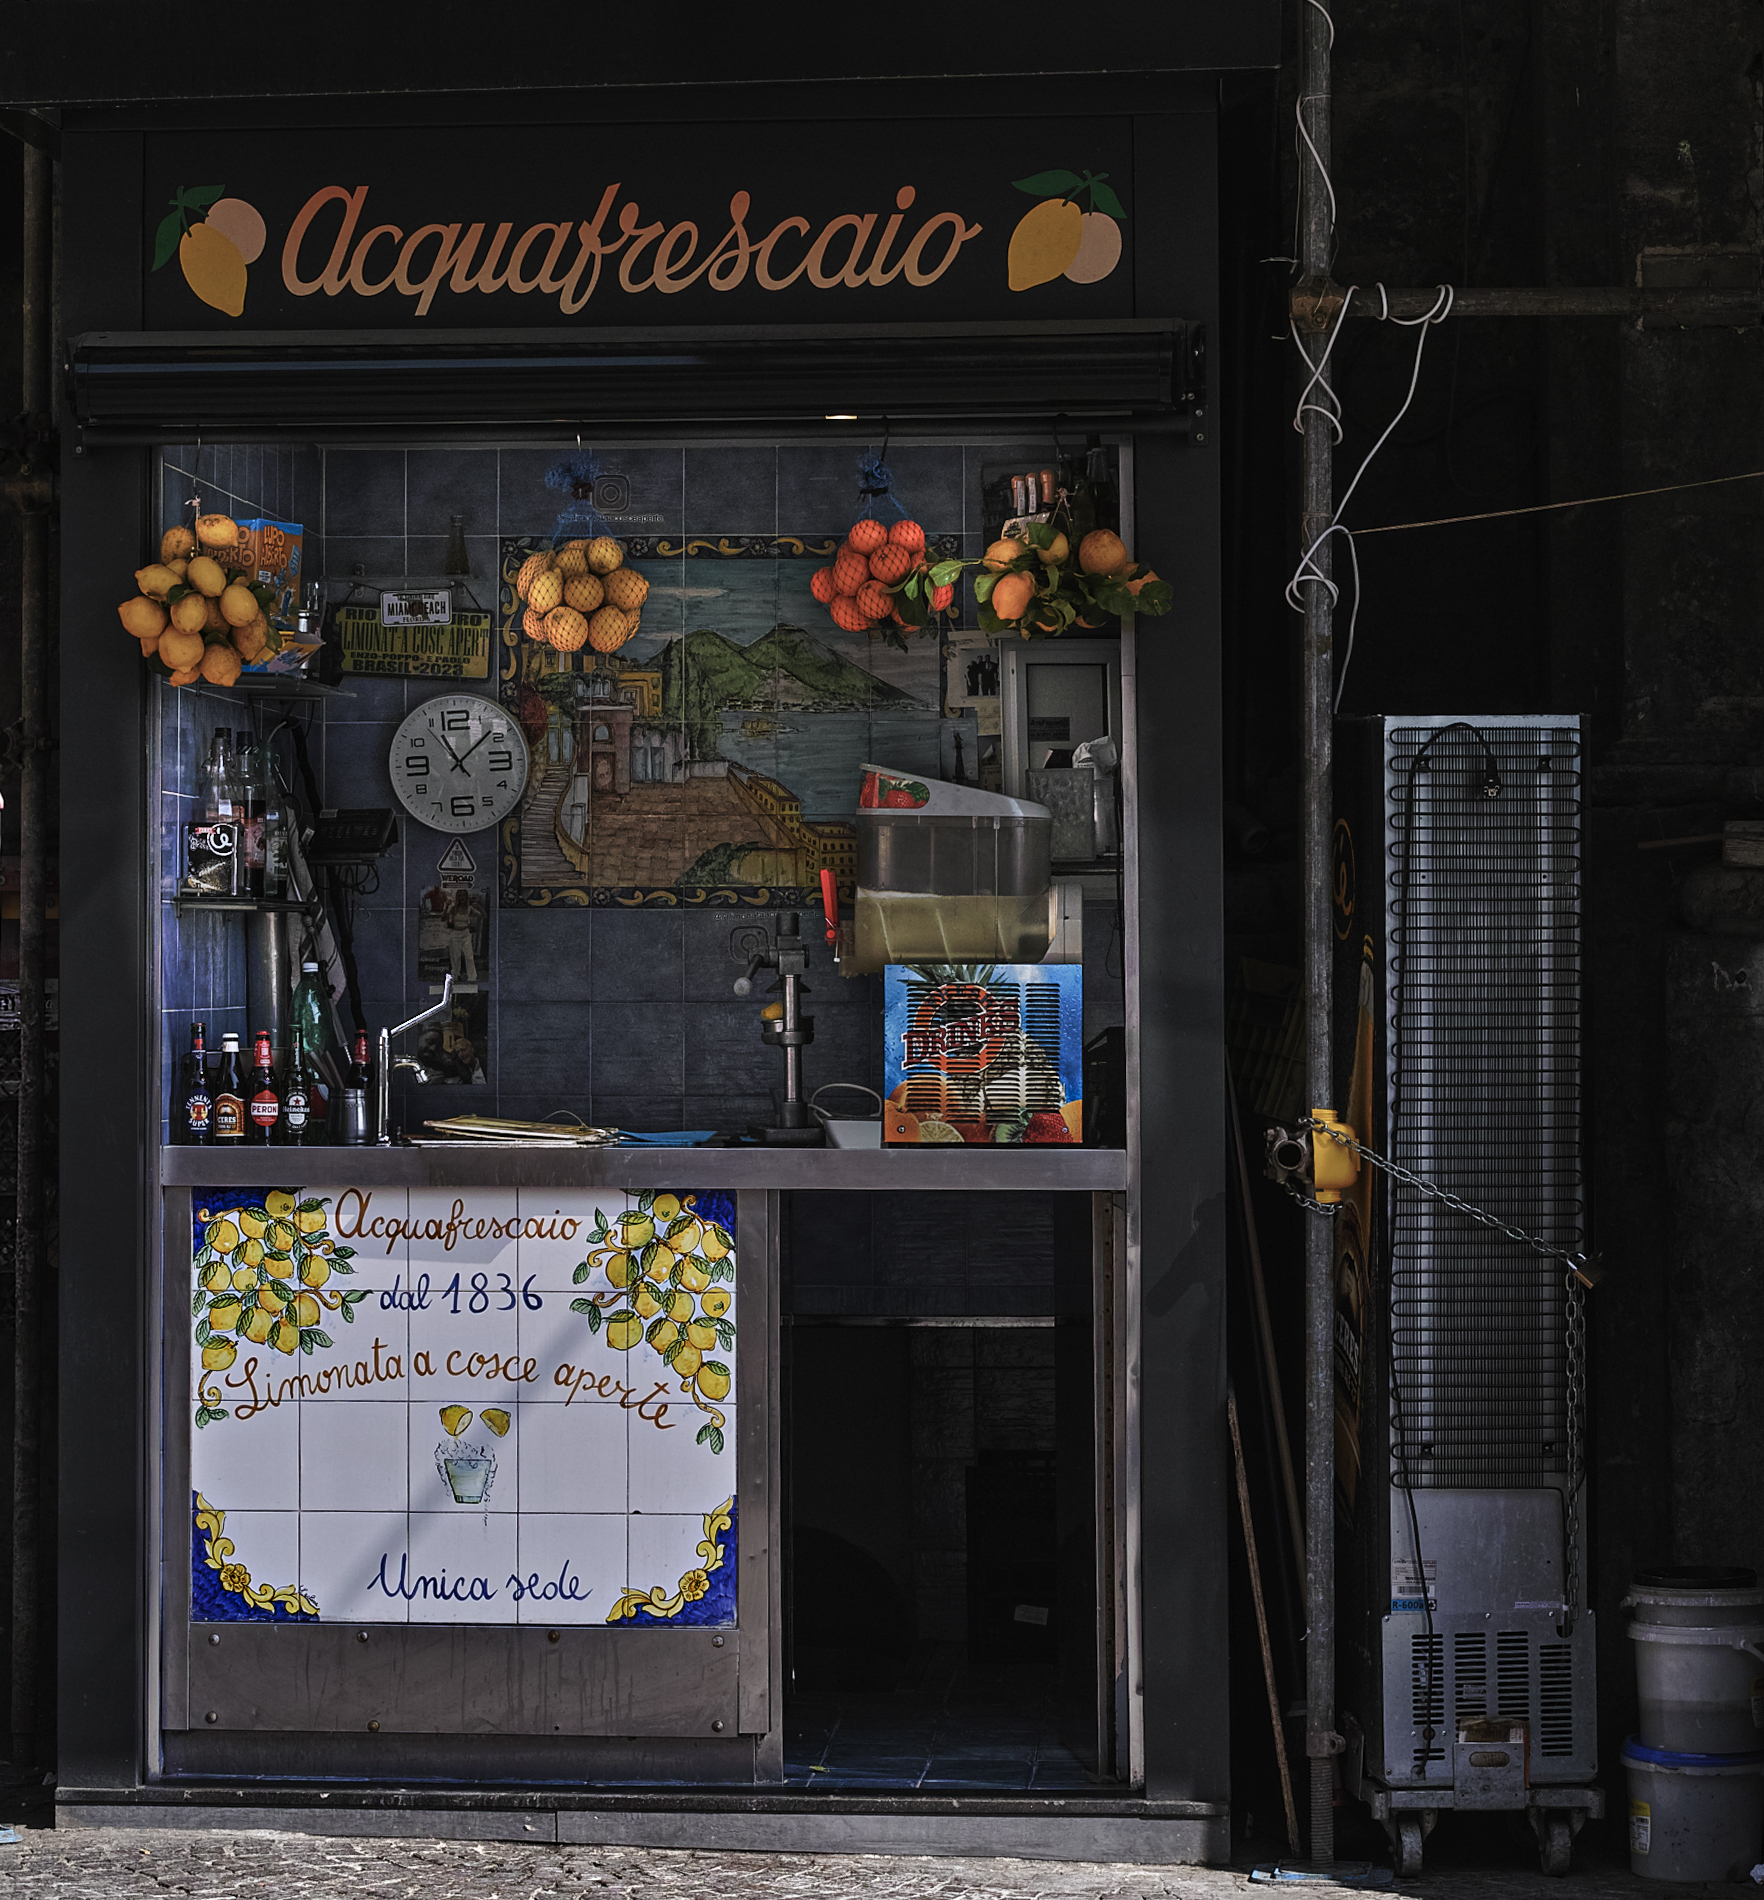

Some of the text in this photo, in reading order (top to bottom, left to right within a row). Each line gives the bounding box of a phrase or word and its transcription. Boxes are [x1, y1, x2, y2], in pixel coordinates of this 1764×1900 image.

[281, 182, 983, 317] Acquafrescaio
[263, 525, 285, 547] LUPO
[345, 607, 377, 621] RIO
[413, 625, 445, 655] COSC
[352, 659, 464, 677] BRASIL 2023
[435, 656, 471, 665] PAOLO
[440, 709, 471, 732] 12
[410, 737, 425, 748] 10
[492, 732, 505, 743] 2
[405, 755, 430, 777] 9
[488, 750, 513, 772] 3
[415, 784, 428, 795] 8
[496, 780, 508, 790] 4
[431, 801, 443, 812] 7
[450, 795, 475, 817] 6
[482, 796, 494, 807] 5
[441, 874, 474, 883] WEROAD
[335, 1187, 583, 1255] Acquafrescaio
[379, 1271, 544, 1314] dal 1836
[225, 1337, 405, 1420] Limonata
[446, 1349, 541, 1383] cosce
[553, 1362, 677, 1430] aperte
[366, 1552, 499, 1601] Unica
[505, 1559, 594, 1602] sede
[1392, 1600, 1425, 1610] R-600a
